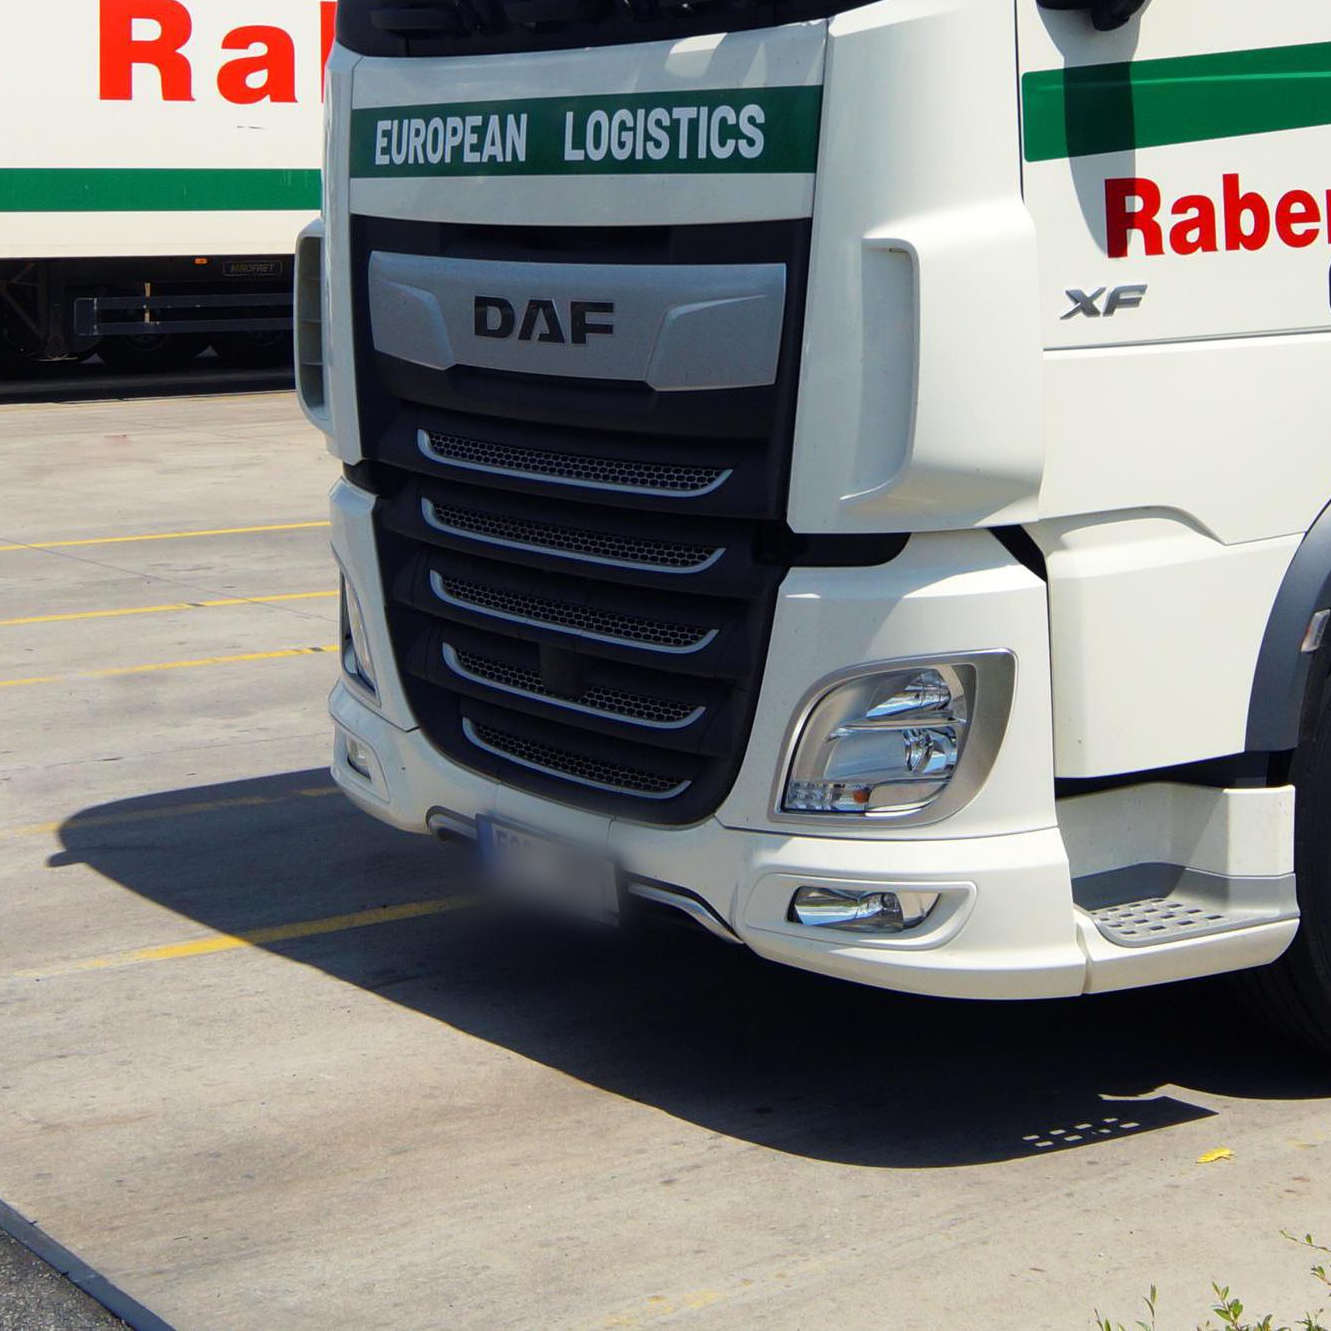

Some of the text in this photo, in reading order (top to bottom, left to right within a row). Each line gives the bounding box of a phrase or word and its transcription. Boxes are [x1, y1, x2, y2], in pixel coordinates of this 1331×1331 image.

[374, 103, 767, 166] EUROPEAN LOGISTICS
[474, 294, 615, 346] DAF
[1059, 283, 1149, 321] XF
